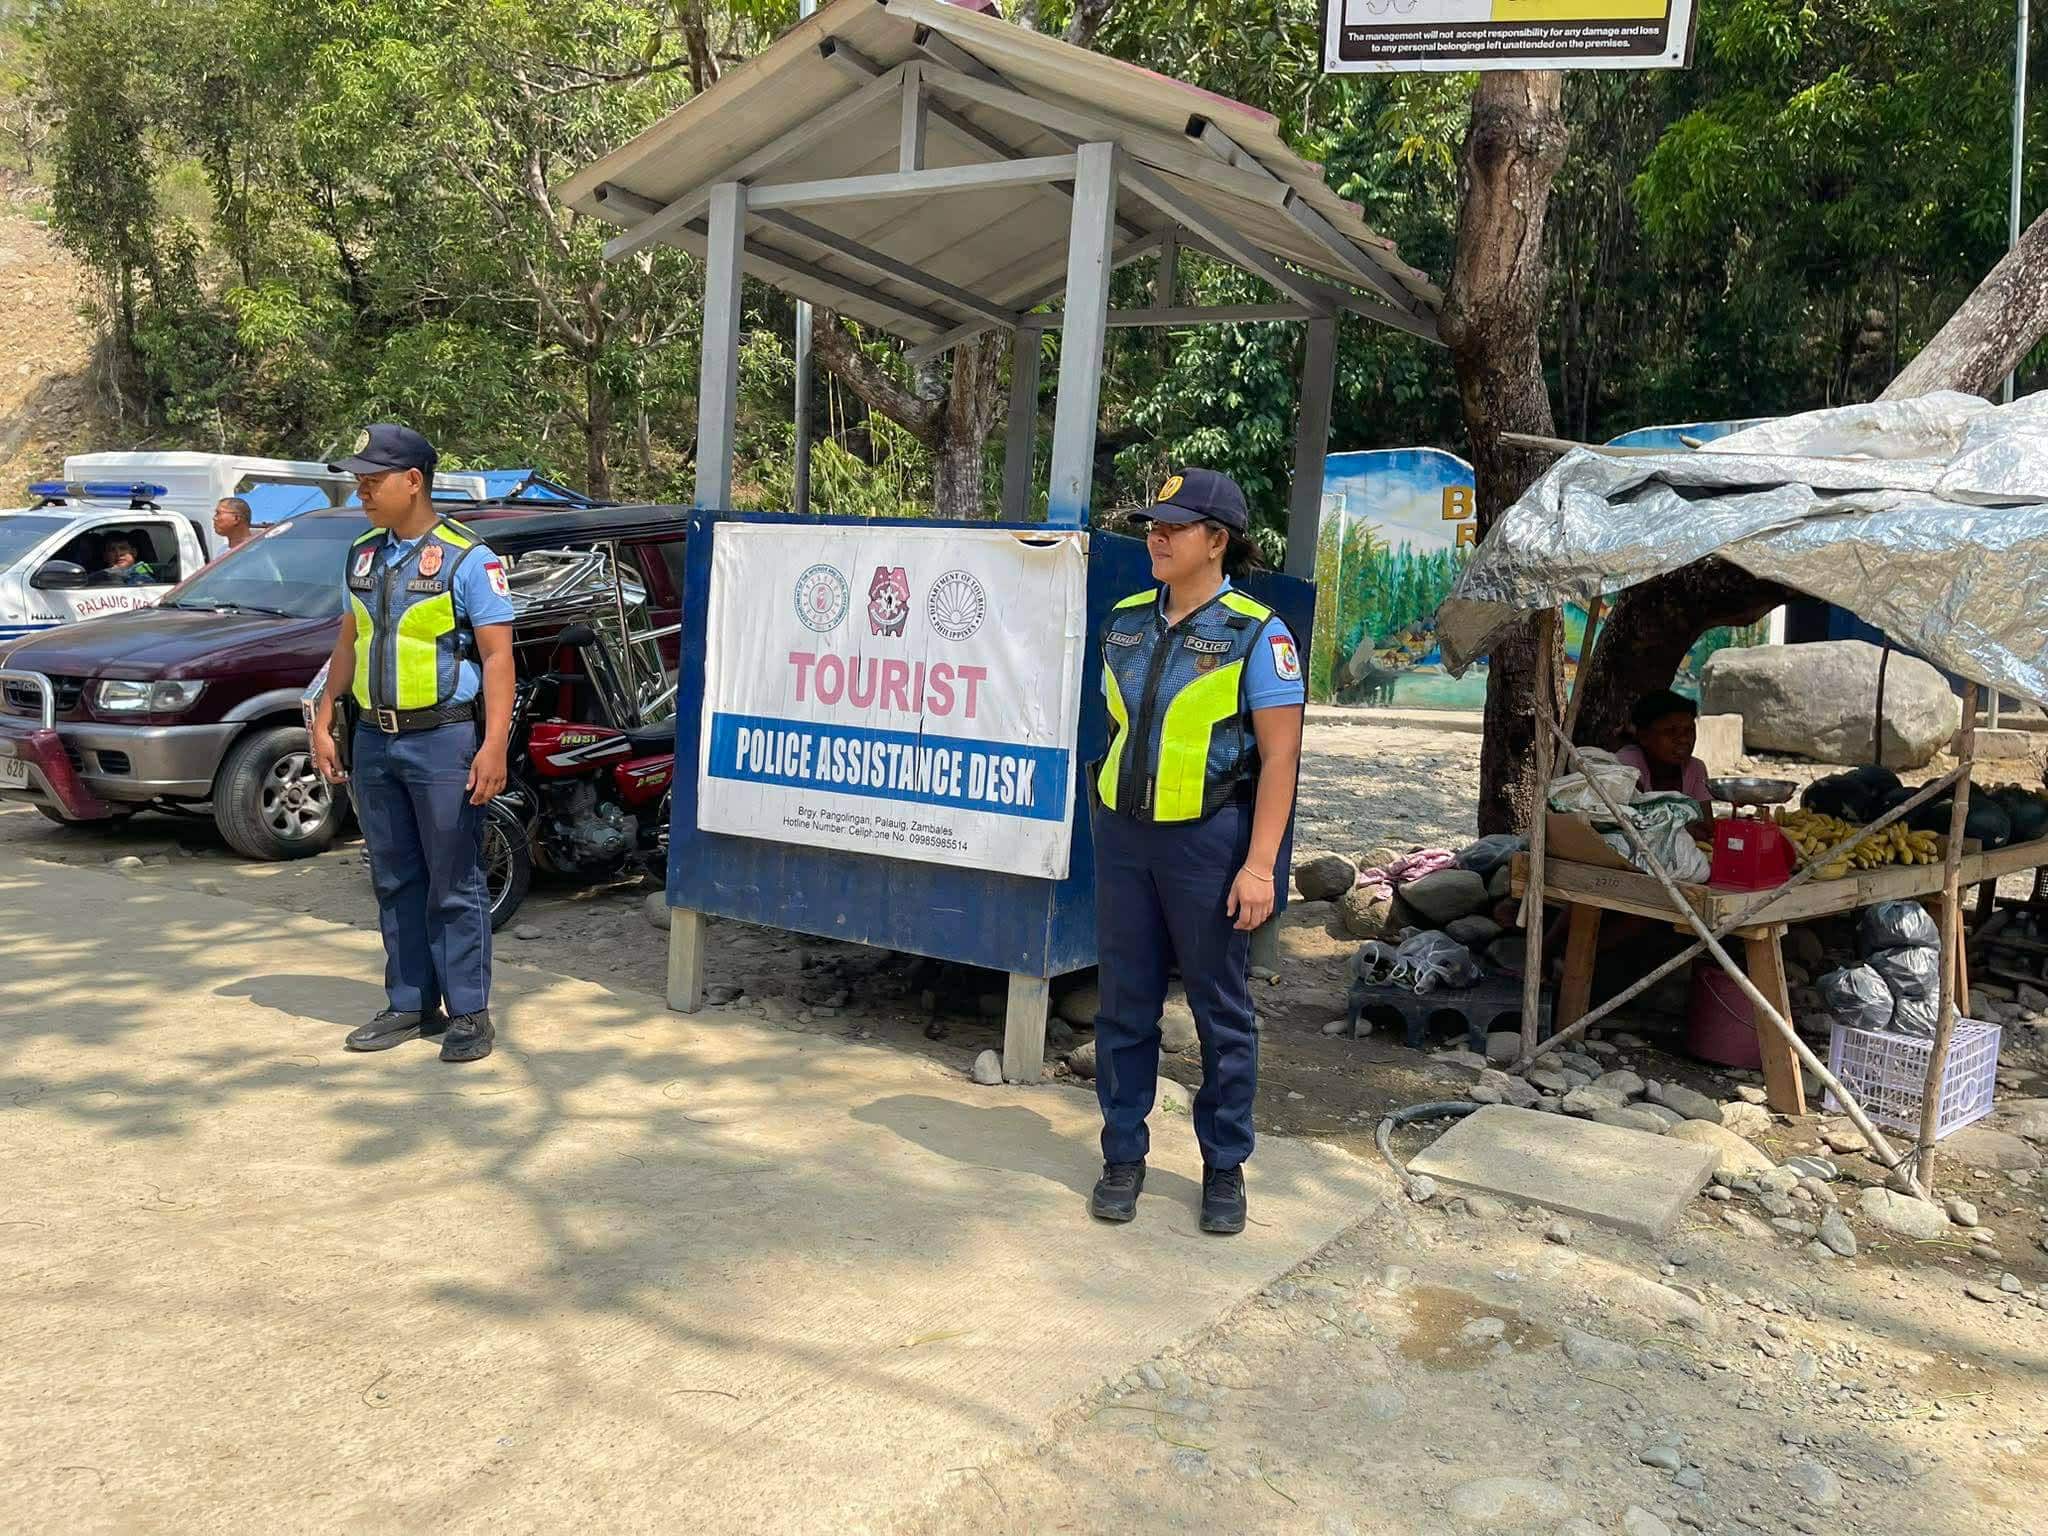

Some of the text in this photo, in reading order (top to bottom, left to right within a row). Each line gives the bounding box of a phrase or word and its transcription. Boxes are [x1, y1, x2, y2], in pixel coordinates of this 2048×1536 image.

[1348, 26, 1659, 42] The management will not accept responsibility for any damage and loss
[1371, 38, 1631, 53] to any personal belongings left unattended on the premises.
[408, 580, 441, 590] POLICE
[930, 573, 959, 615] DEPARTMENT
[76, 595, 129, 616] PALAUIG
[934, 621, 977, 639] PHILIPPINES
[1187, 639, 1229, 650] POLICE
[789, 651, 987, 718] TOURIST
[6, 759, 25, 778] 628
[735, 727, 1036, 807] POLICE ASSISTANCE DESK
[820, 808, 872, 827] Pangolingan,
[911, 820, 953, 836] Zambales
[783, 815, 810, 829] Hotline
[848, 825, 890, 840] Cellphone
[909, 833, 968, 851] 09985985514
